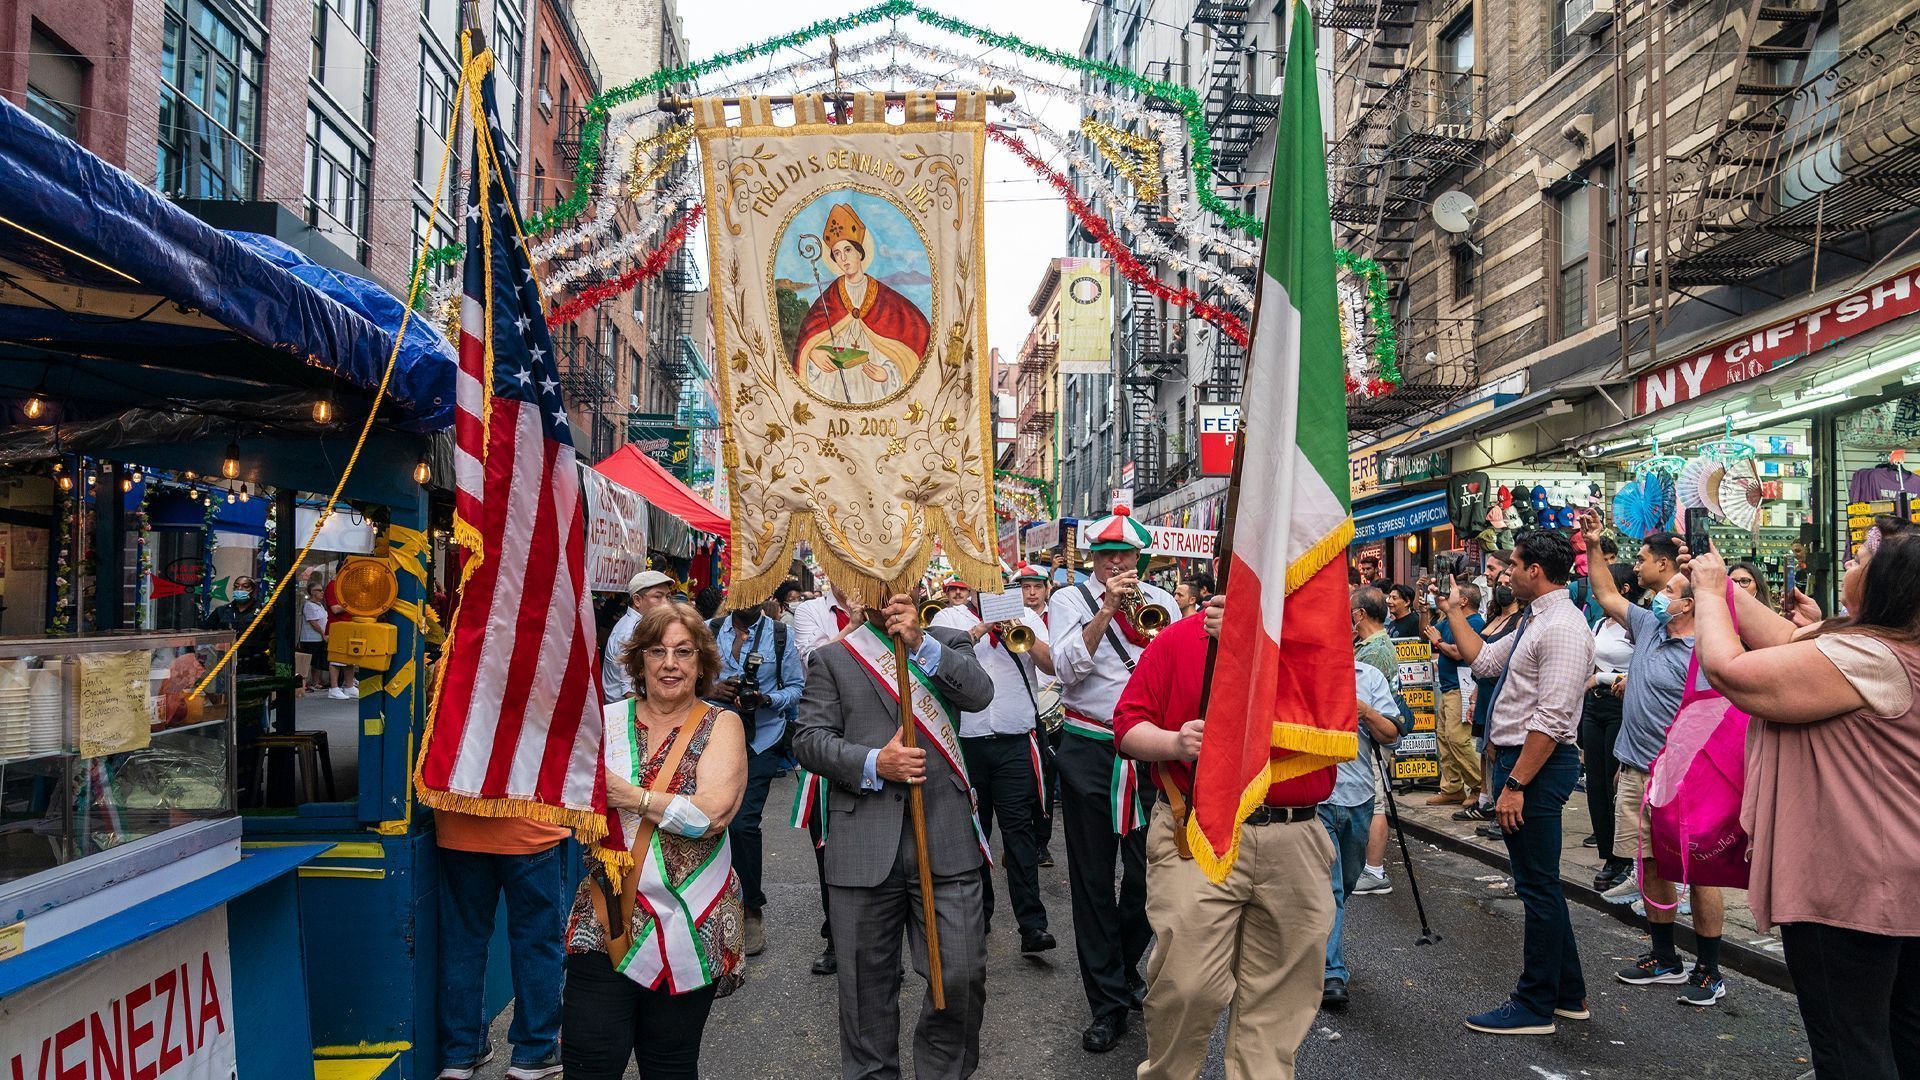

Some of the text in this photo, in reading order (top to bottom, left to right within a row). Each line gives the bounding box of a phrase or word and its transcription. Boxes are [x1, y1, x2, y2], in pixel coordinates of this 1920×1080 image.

[752, 150, 935, 219] FIGLI DI S. GENNARO INC.
[1645, 353, 1715, 413] NY
[1223, 407, 1240, 417] LA
[827, 416, 898, 438] A.D. 2000
[1461, 484, 1469, 495] I
[1460, 492, 1483, 507] NY
[1378, 516, 1406, 534] ESPRESSO
[1395, 645, 1429, 657] ROOKLYN
[875, 651, 898, 680] Fig
[916, 695, 939, 722] San
[1408, 692, 1432, 703] APPLE
[1398, 762, 1436, 775] BIG APPLE
